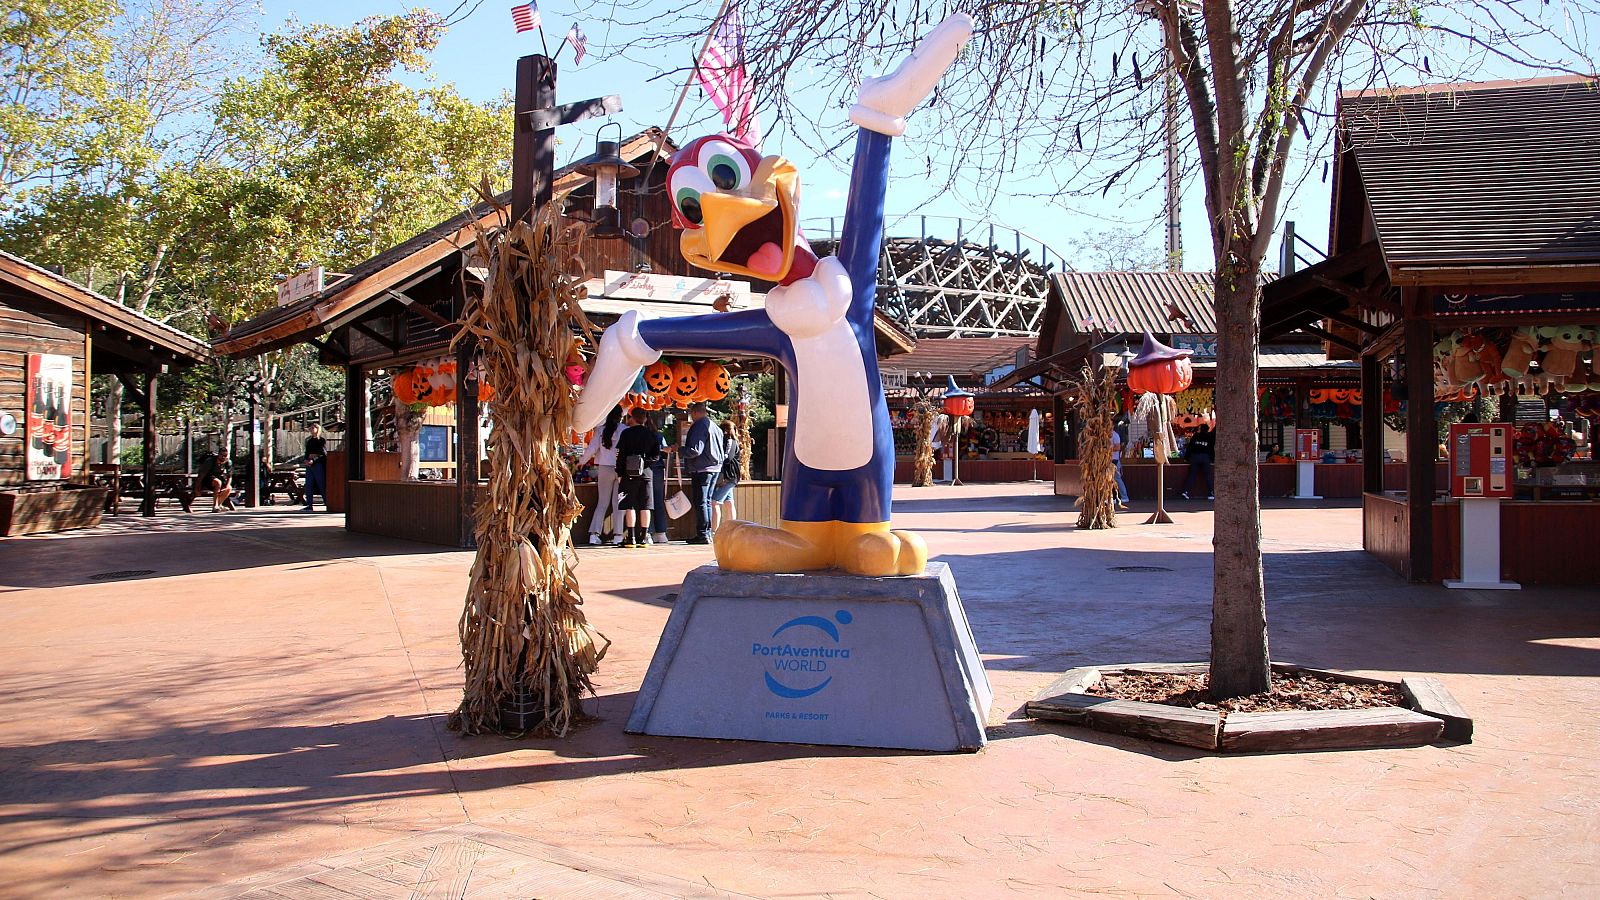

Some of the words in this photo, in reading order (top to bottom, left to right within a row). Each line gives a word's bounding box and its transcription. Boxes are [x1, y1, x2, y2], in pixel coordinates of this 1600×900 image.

[752, 643, 850, 659] PortAventura
[774, 659, 827, 672] WORLD
[765, 711, 790, 720] PARKS
[798, 712, 829, 720] RESORT
